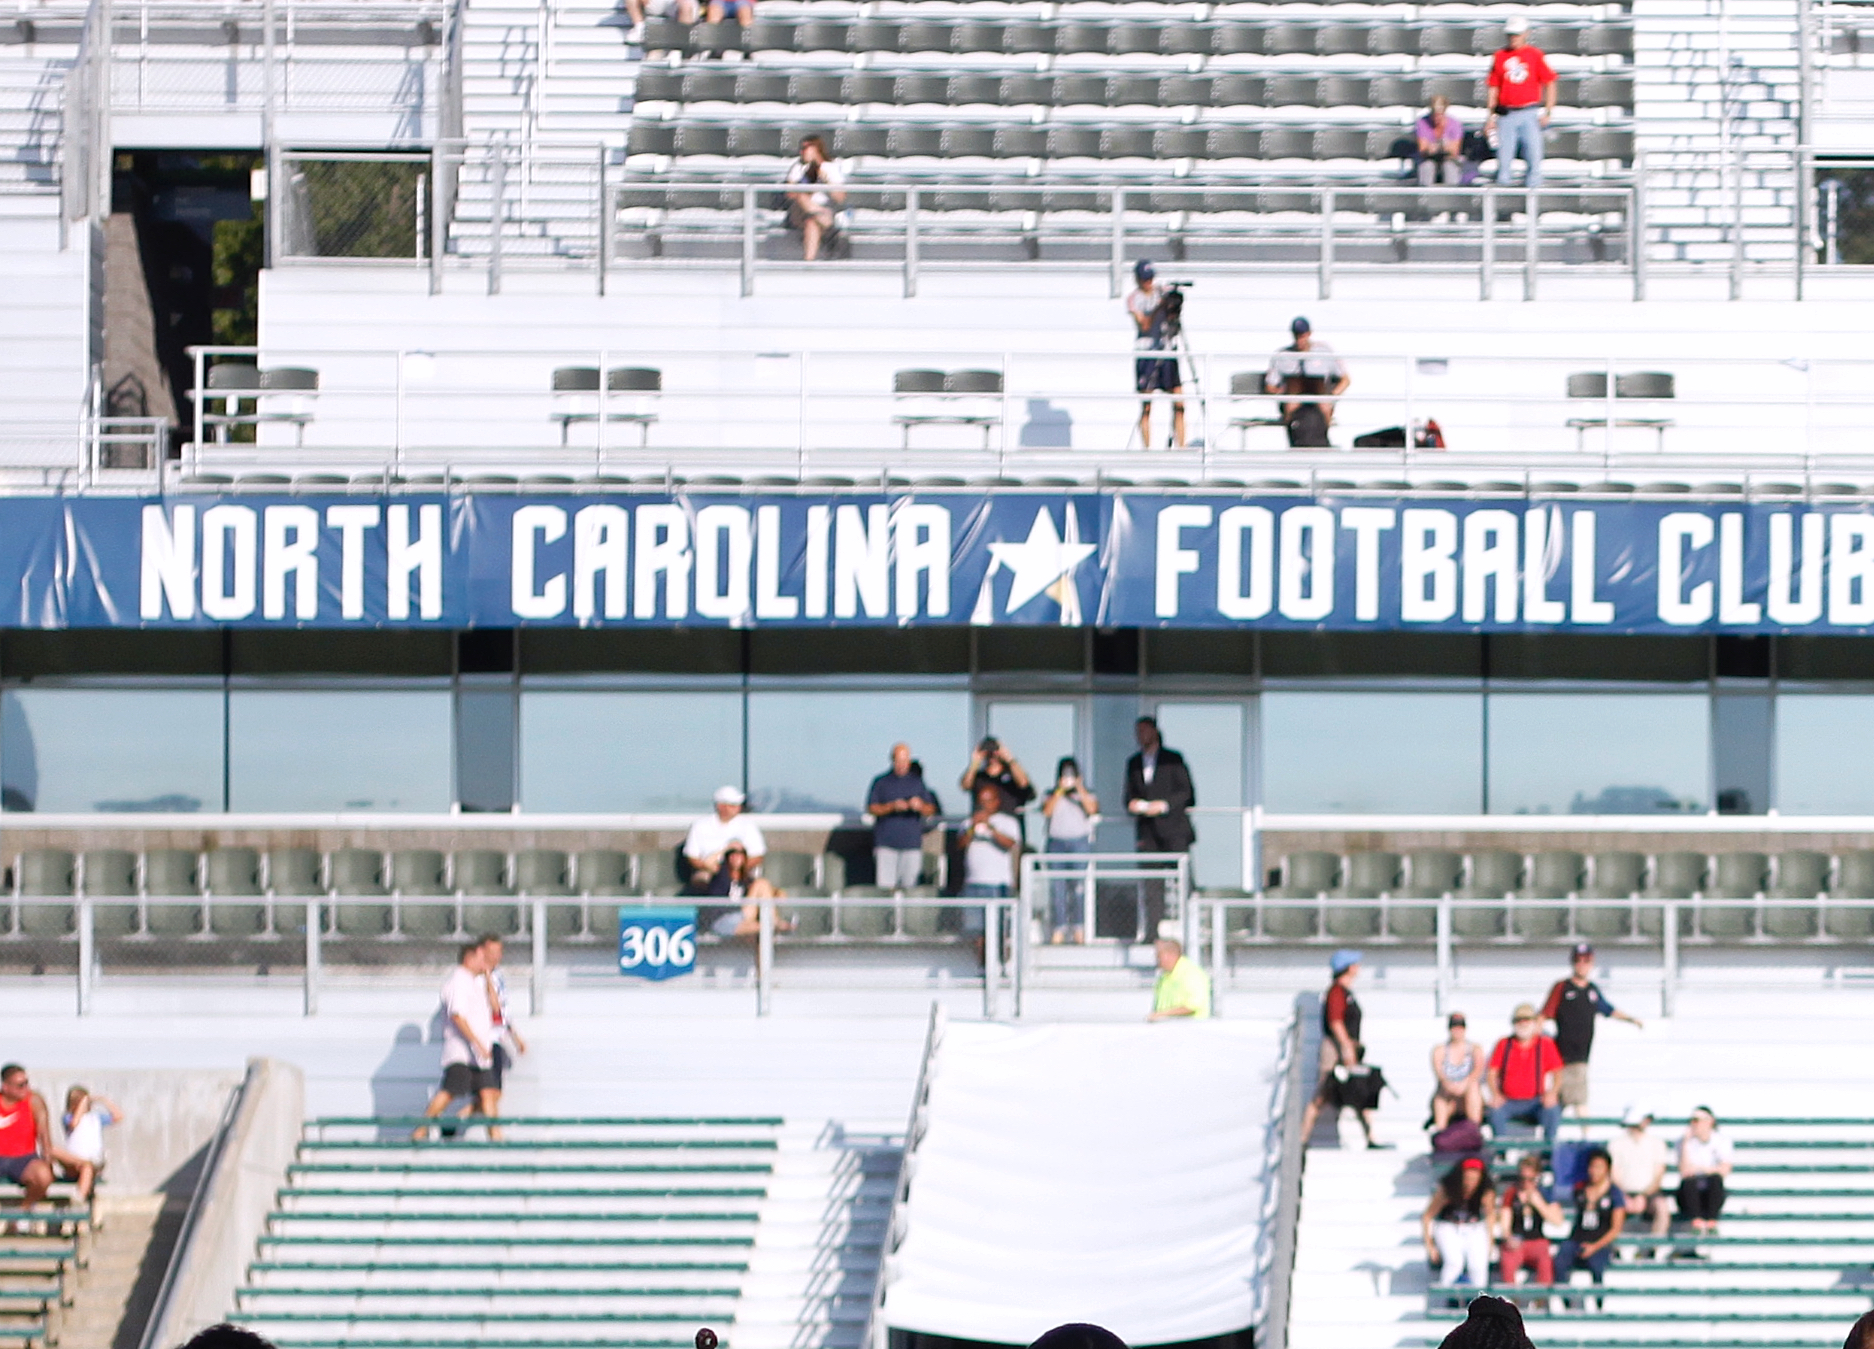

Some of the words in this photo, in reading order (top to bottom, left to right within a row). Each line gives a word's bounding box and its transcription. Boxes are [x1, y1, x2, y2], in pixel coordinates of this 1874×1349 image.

[141, 505, 442, 619] NORTH
[512, 505, 951, 620] CAROLINA
[1155, 505, 1615, 624] FOOTBALL
[622, 925, 695, 967] 306
